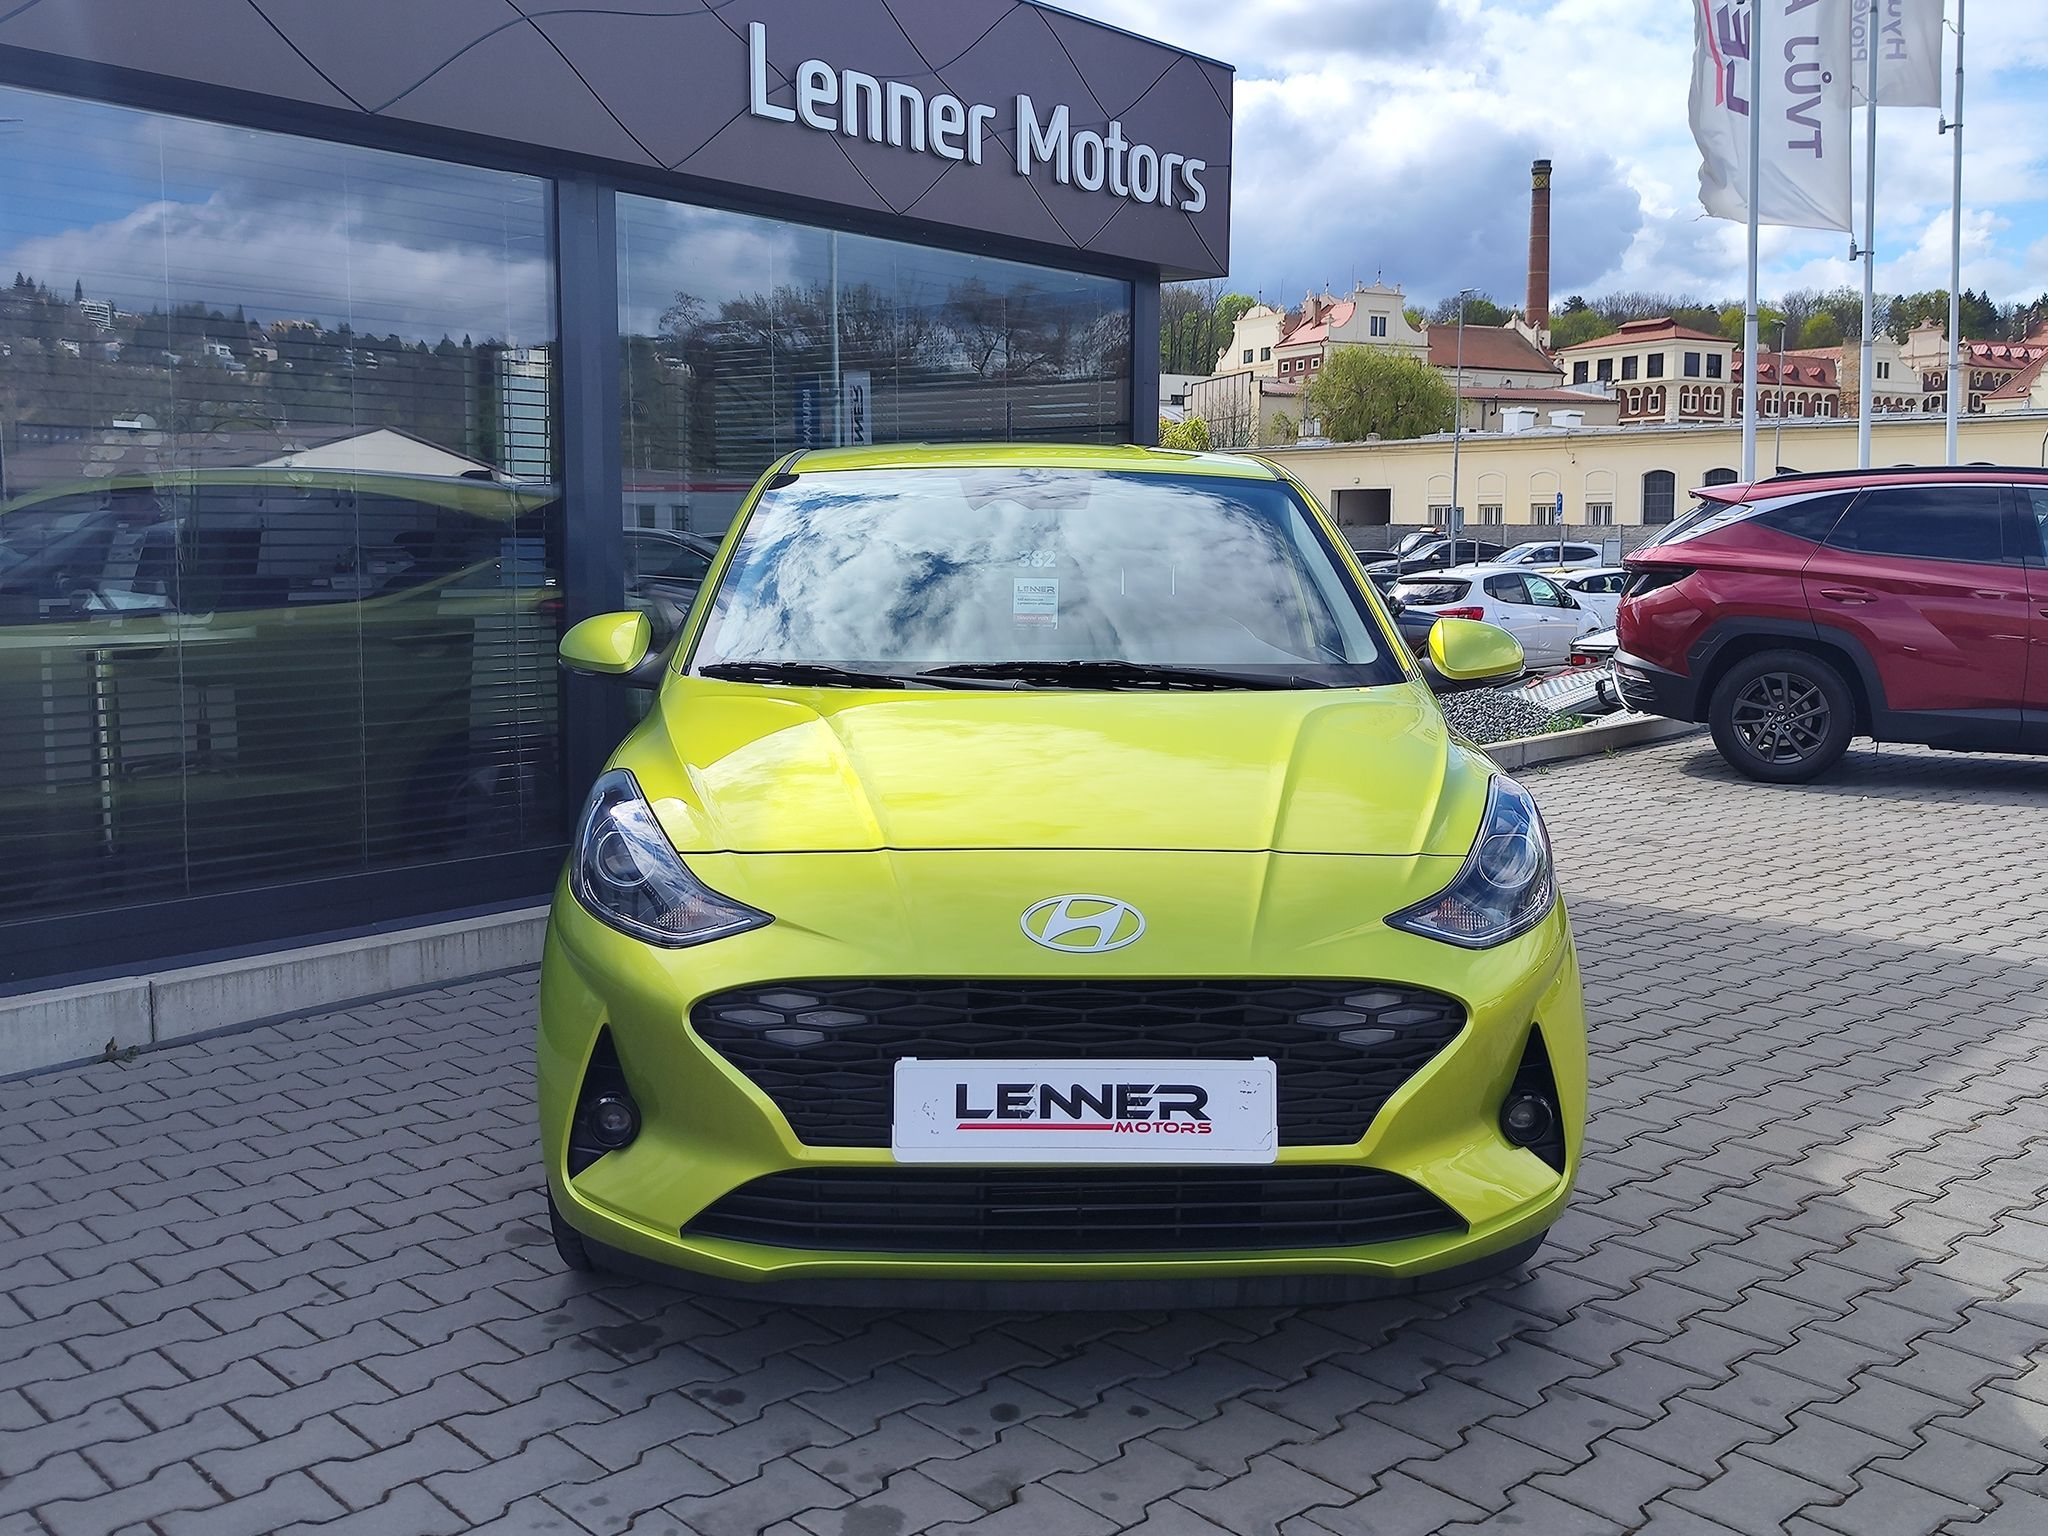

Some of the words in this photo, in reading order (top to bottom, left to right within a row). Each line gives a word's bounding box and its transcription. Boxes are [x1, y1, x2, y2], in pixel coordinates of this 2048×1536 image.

[748, 21, 997, 166] Lenner
[1016, 94, 1207, 213] Motors
[1018, 550, 1056, 568] 382
[955, 1083, 1212, 1121] LENNER
[1115, 1122, 1212, 1134] MOTORS
